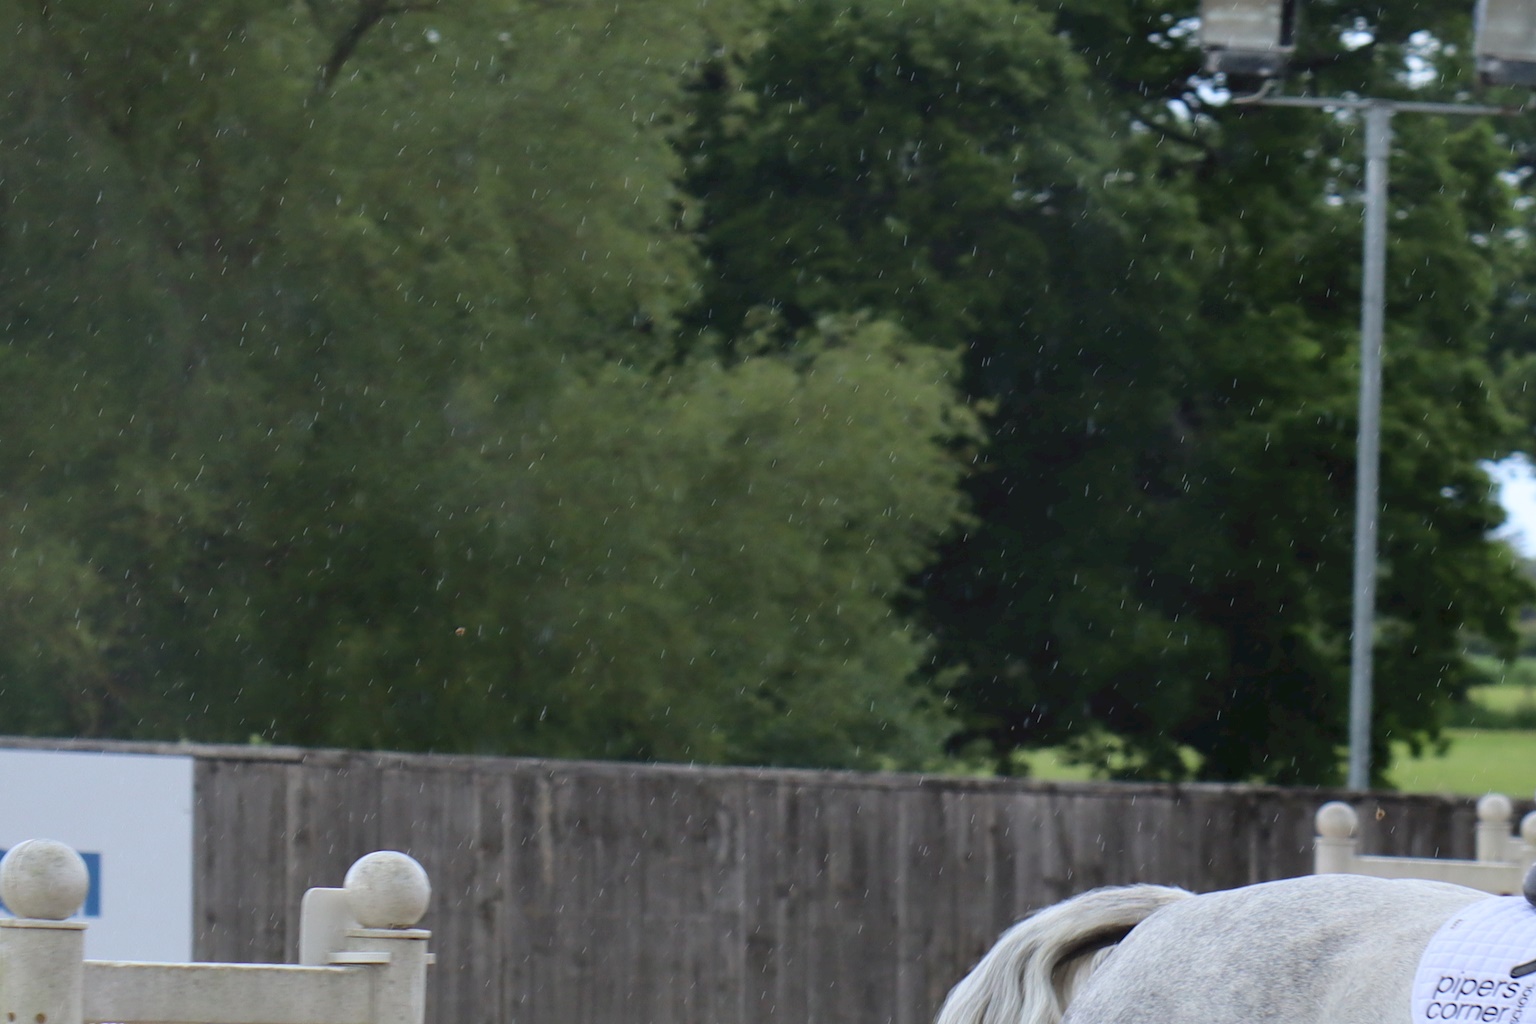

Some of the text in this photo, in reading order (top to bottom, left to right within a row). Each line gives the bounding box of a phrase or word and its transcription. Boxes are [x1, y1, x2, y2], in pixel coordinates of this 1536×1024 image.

[1433, 971, 1520, 1000] pipers
[1425, 1002, 1509, 1023] corner
[1509, 983, 1535, 1024] SCHOOL
